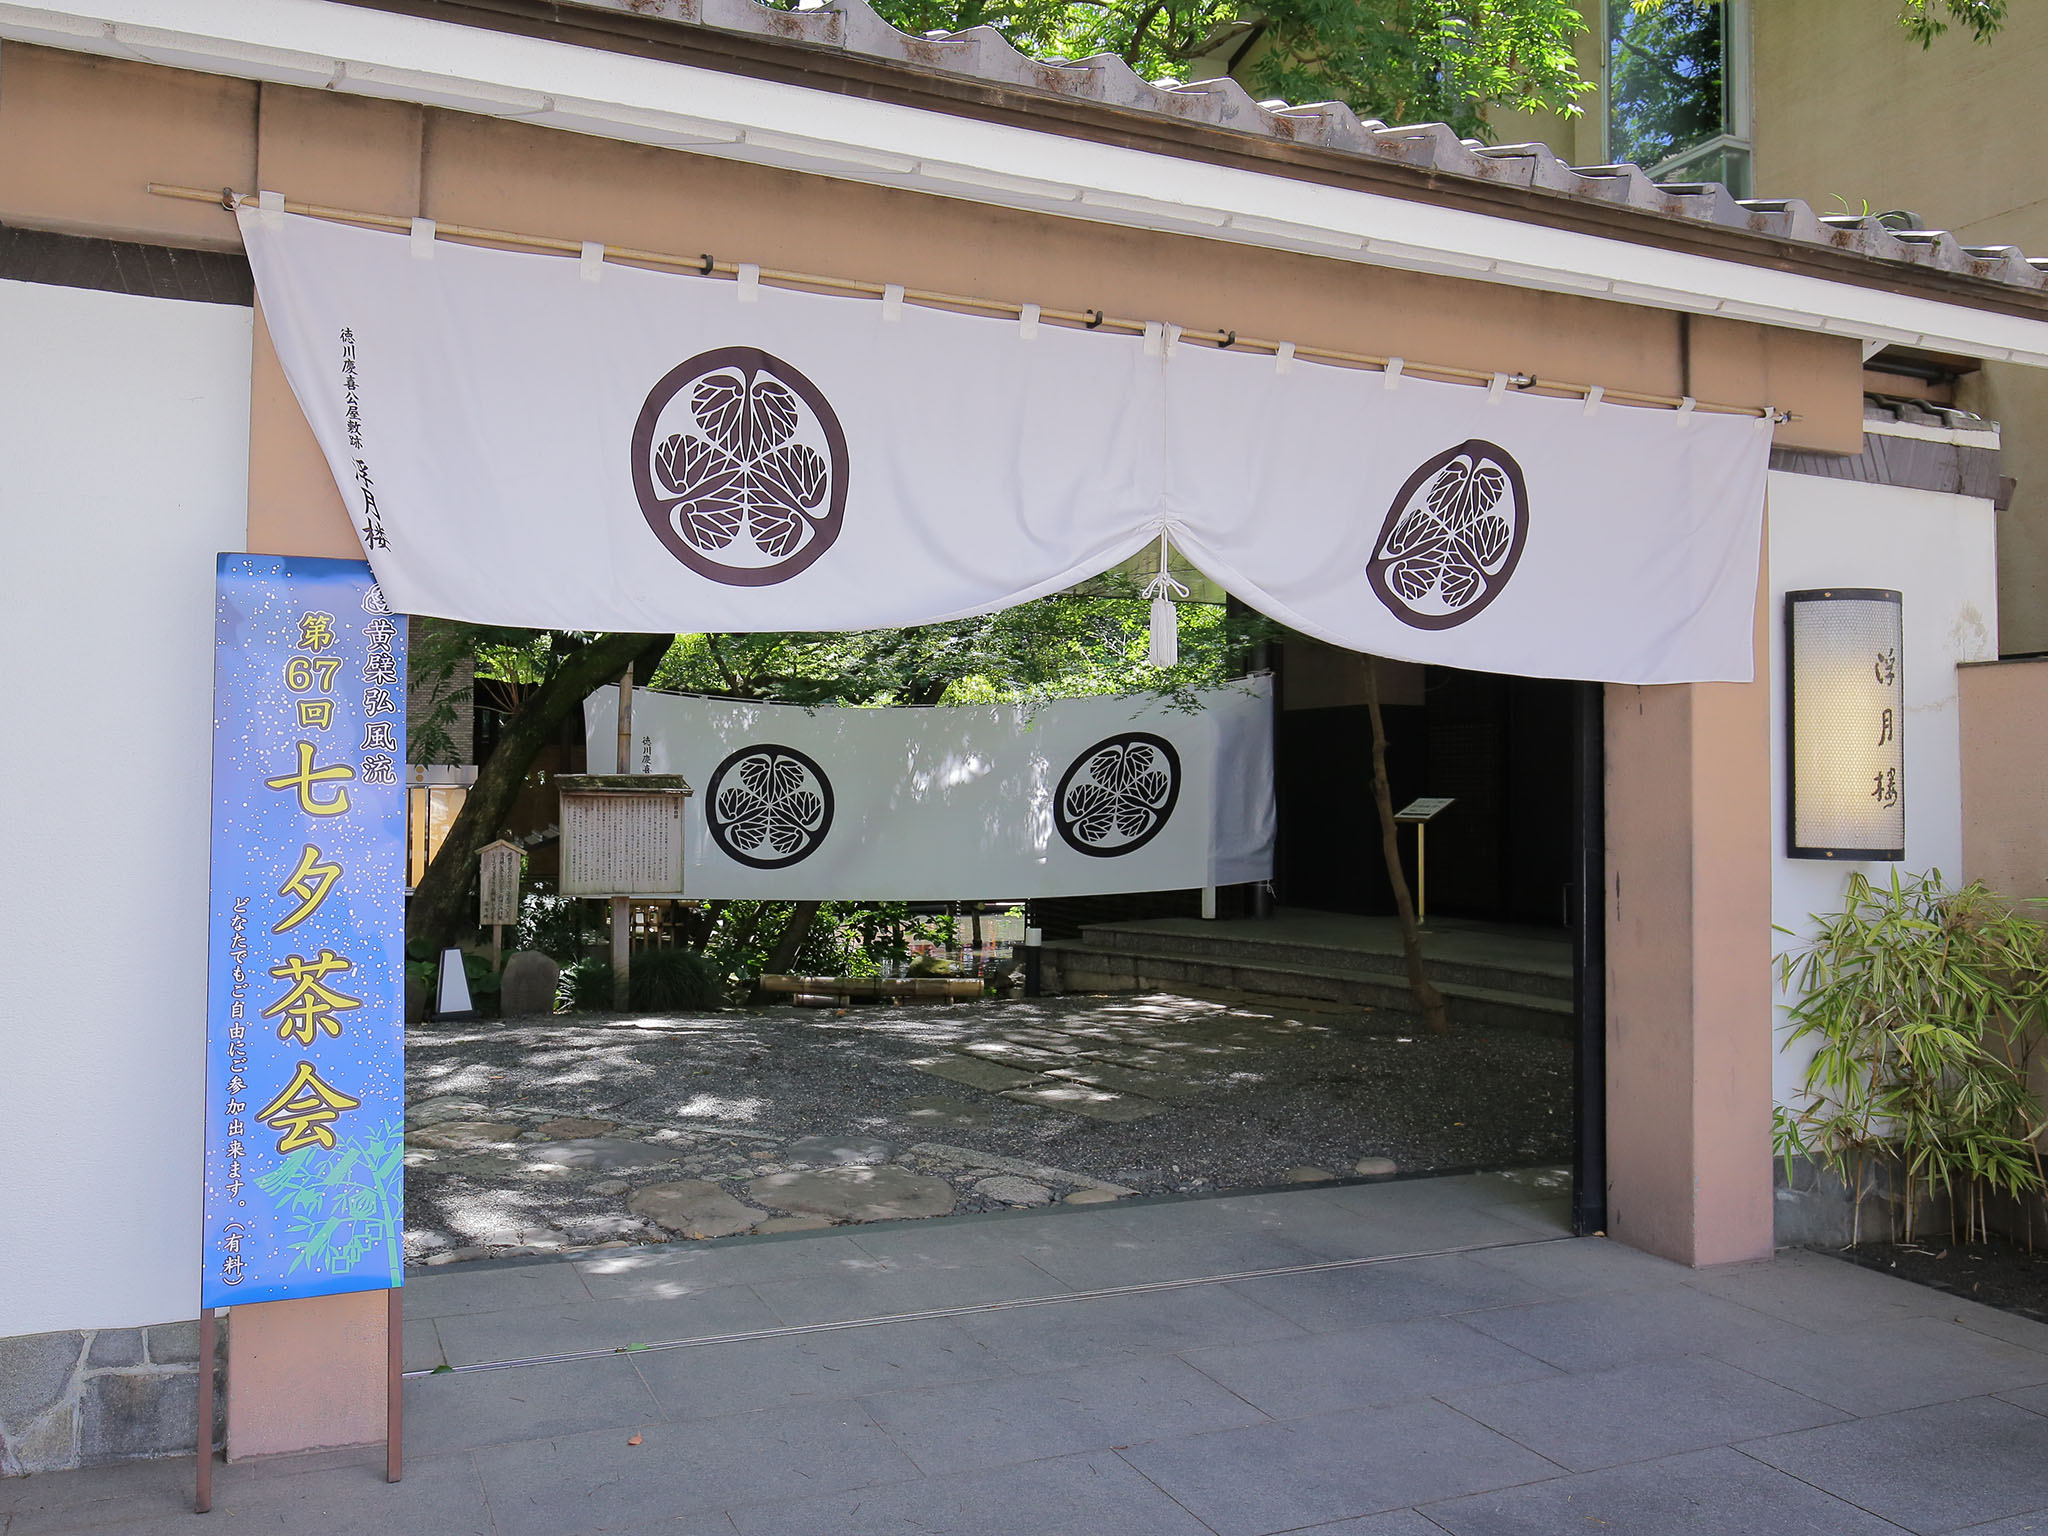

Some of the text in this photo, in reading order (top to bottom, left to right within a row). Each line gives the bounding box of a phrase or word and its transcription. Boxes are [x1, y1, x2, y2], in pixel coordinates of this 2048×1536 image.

[361, 618, 397, 785] 黄檗弘風流
[255, 610, 361, 1154] 第67回 七夕茶会
[224, 896, 251, 1208] どなたでもご自由にご参加出来ます。
